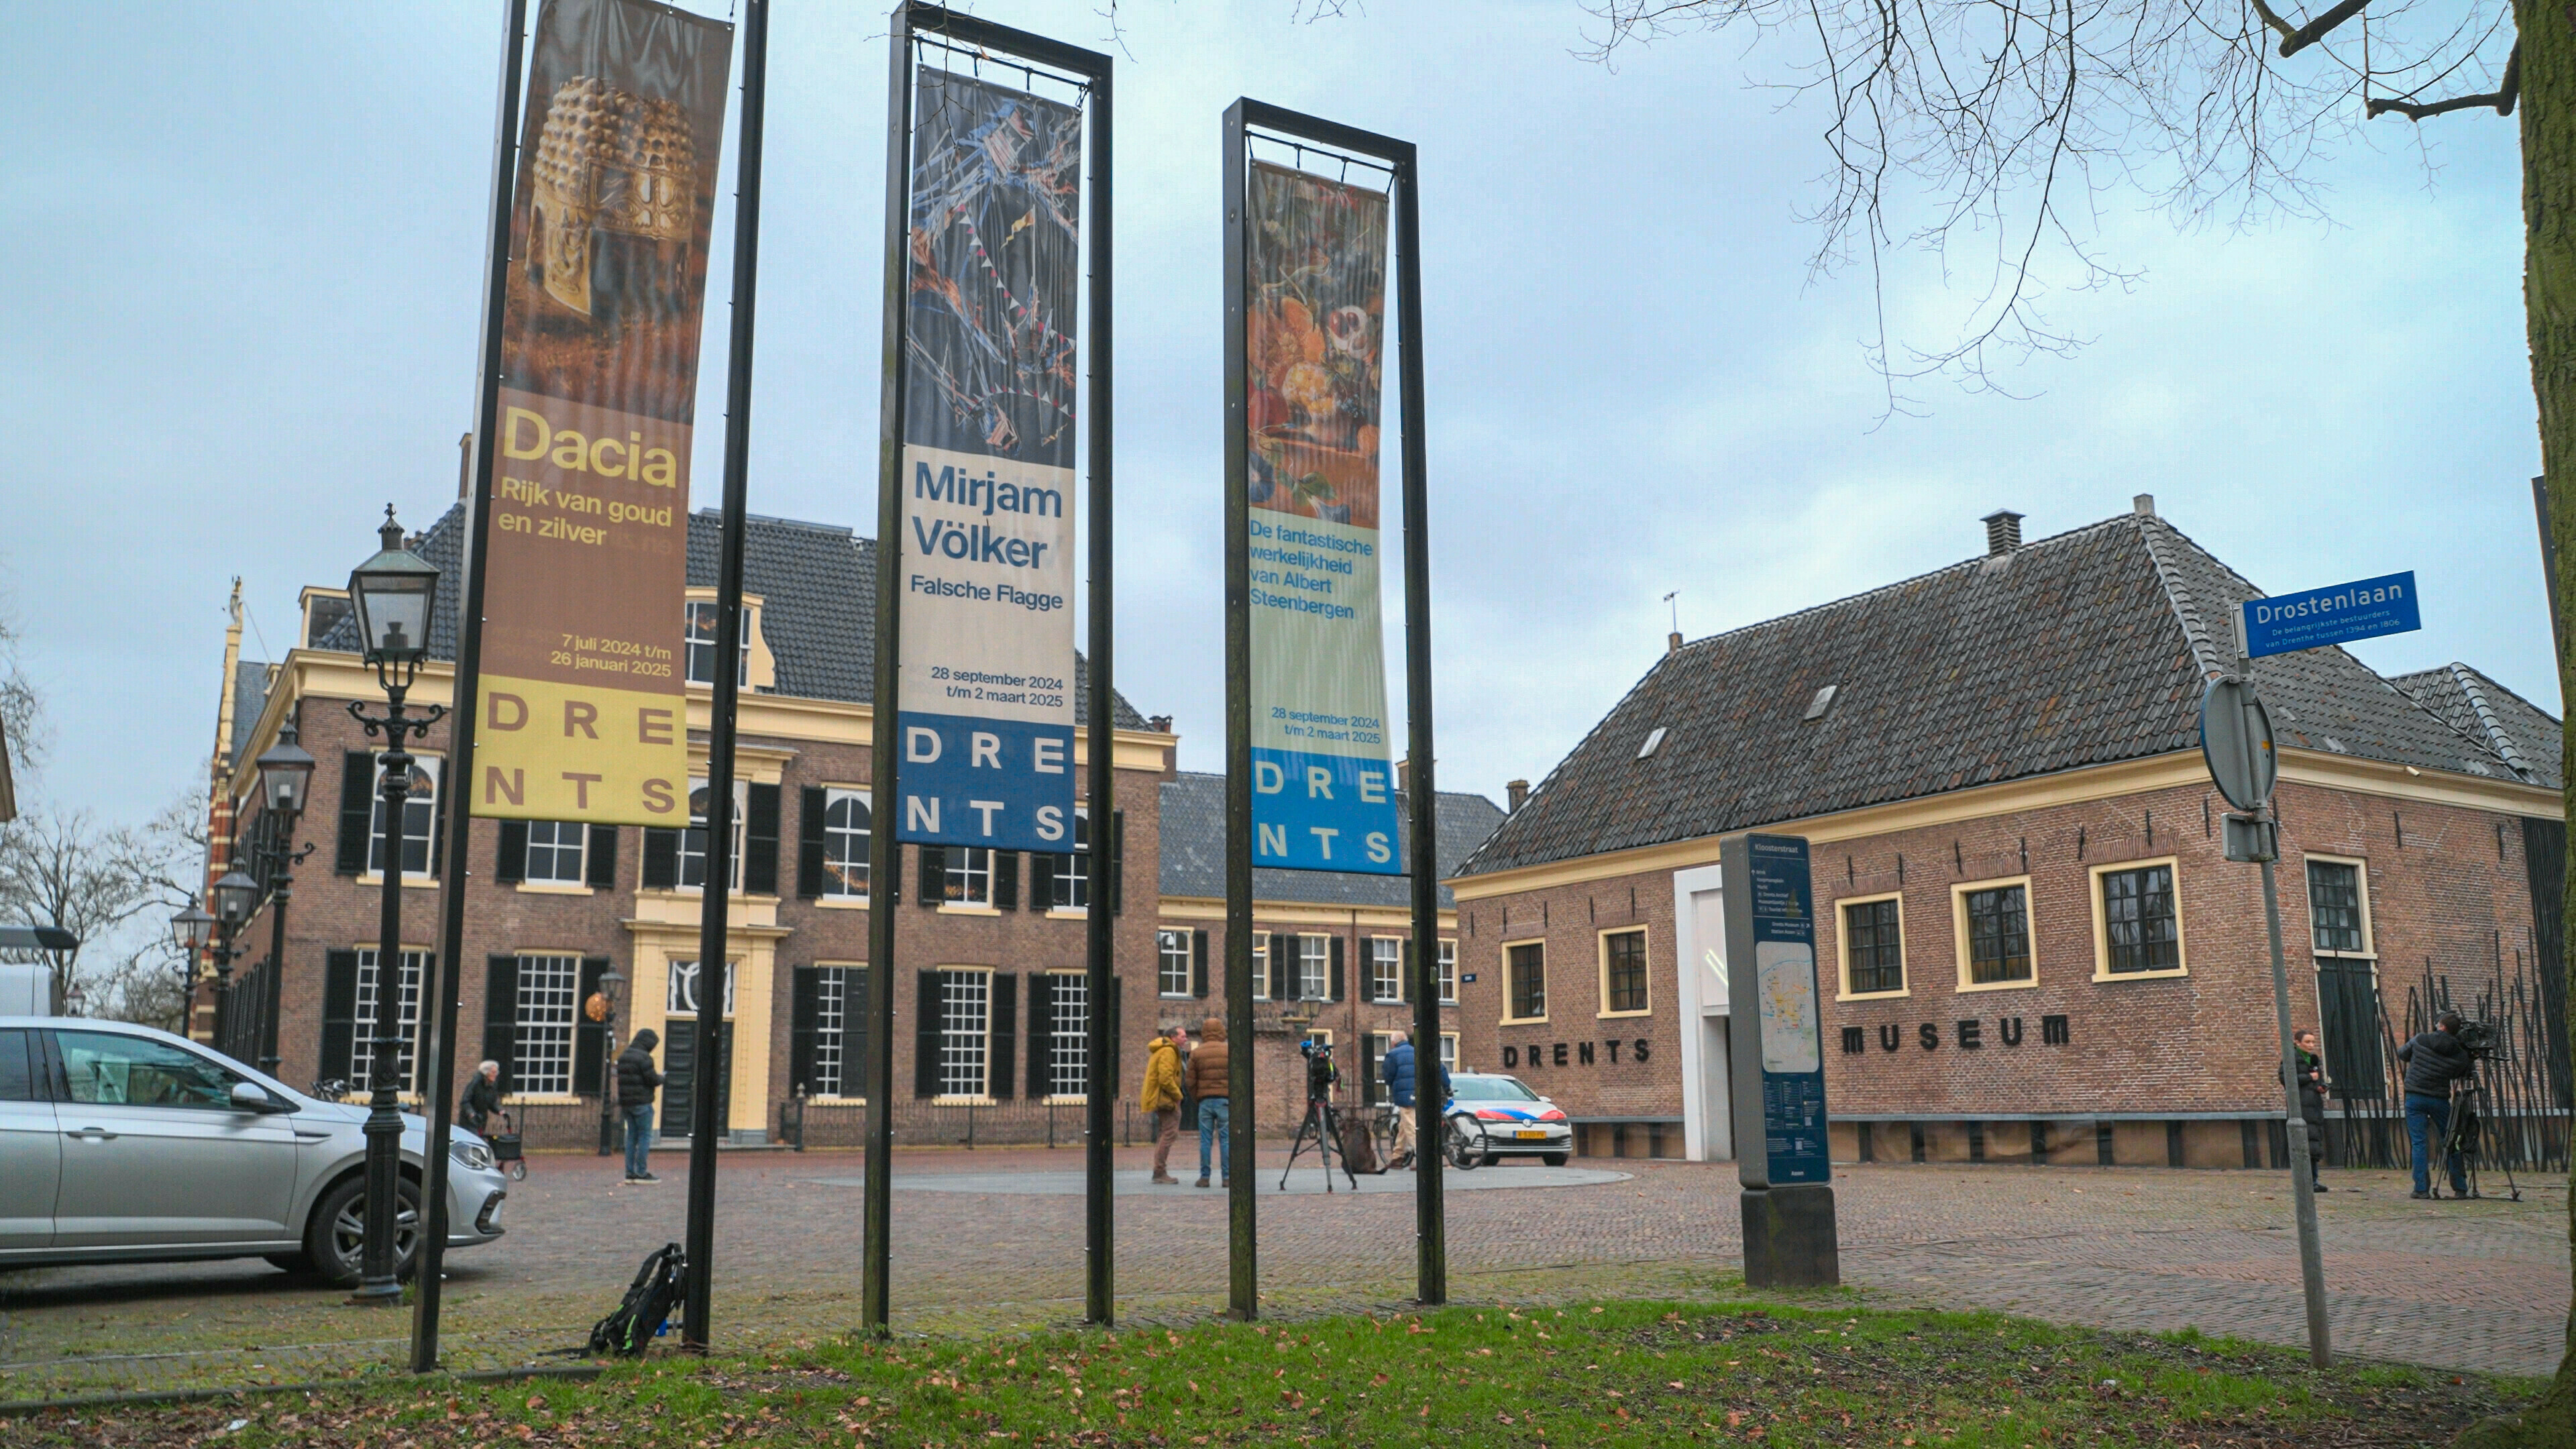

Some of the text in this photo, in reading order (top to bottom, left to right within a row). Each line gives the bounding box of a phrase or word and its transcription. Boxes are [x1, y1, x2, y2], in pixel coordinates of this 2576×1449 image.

[502, 405, 677, 488] Dacia
[501, 476, 672, 527] Rijk van goud
[915, 461, 1062, 518] Mirjam
[498, 513, 531, 533] en
[539, 520, 606, 545] zilver
[912, 515, 1047, 570] Völker
[1250, 520, 1373, 556] De fantastische
[1250, 546, 1352, 575] werkelijkheid
[911, 575, 1063, 612] Falsche Flagge
[1250, 570, 1332, 593] van Albert
[1250, 589, 1354, 619] Steenbergen
[2257, 584, 2402, 624] Drostenlaan
[2266, 640, 2279, 648] van
[2282, 634, 2314, 645] Drenthe
[2317, 629, 2343, 639] tussen
[2347, 625, 2365, 634] 1394
[2381, 619, 2400, 628] 1806
[2273, 610, 2390, 636] De belangrijkste bestuurders
[562, 634, 671, 659] 7 juli 2024 t/m
[551, 650, 671, 677] 26 januari 2025
[931, 667, 1063, 690] 28 september 2024
[947, 686, 1063, 708] t/m 2 maart 2025
[1272, 707, 1379, 729] 28 september 2024
[1285, 724, 1380, 744] t/m 2 maart 2025
[1755, 844, 1799, 853] Kloosterstraat
[1504, 1014, 2070, 1069] DRENTS MUSEUM
